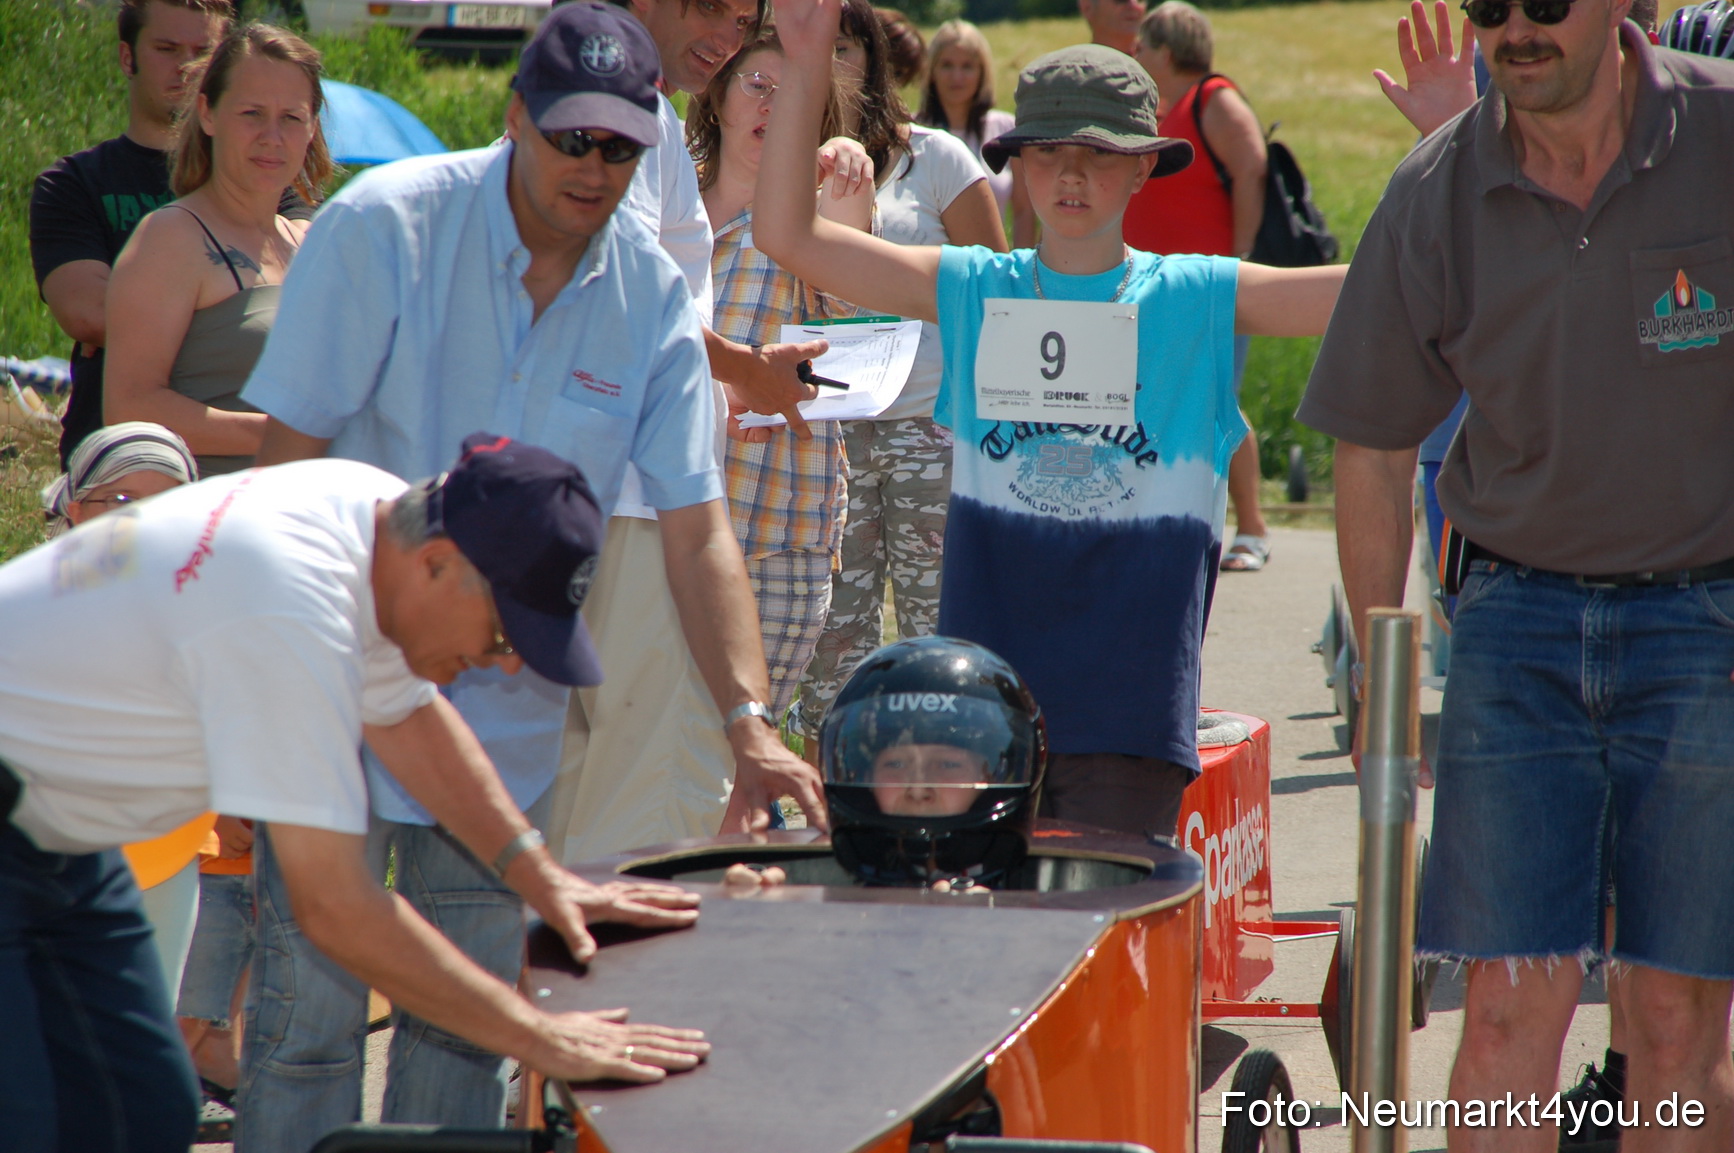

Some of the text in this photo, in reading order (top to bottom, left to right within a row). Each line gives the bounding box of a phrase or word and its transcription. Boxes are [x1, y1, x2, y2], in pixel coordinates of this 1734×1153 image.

[1639, 308, 1734, 338] BURKHARDT
[1040, 331, 1066, 381] 9
[1037, 444, 1093, 476] 25
[888, 692, 958, 713] uvex
[1184, 797, 1264, 929] Sparkasse
